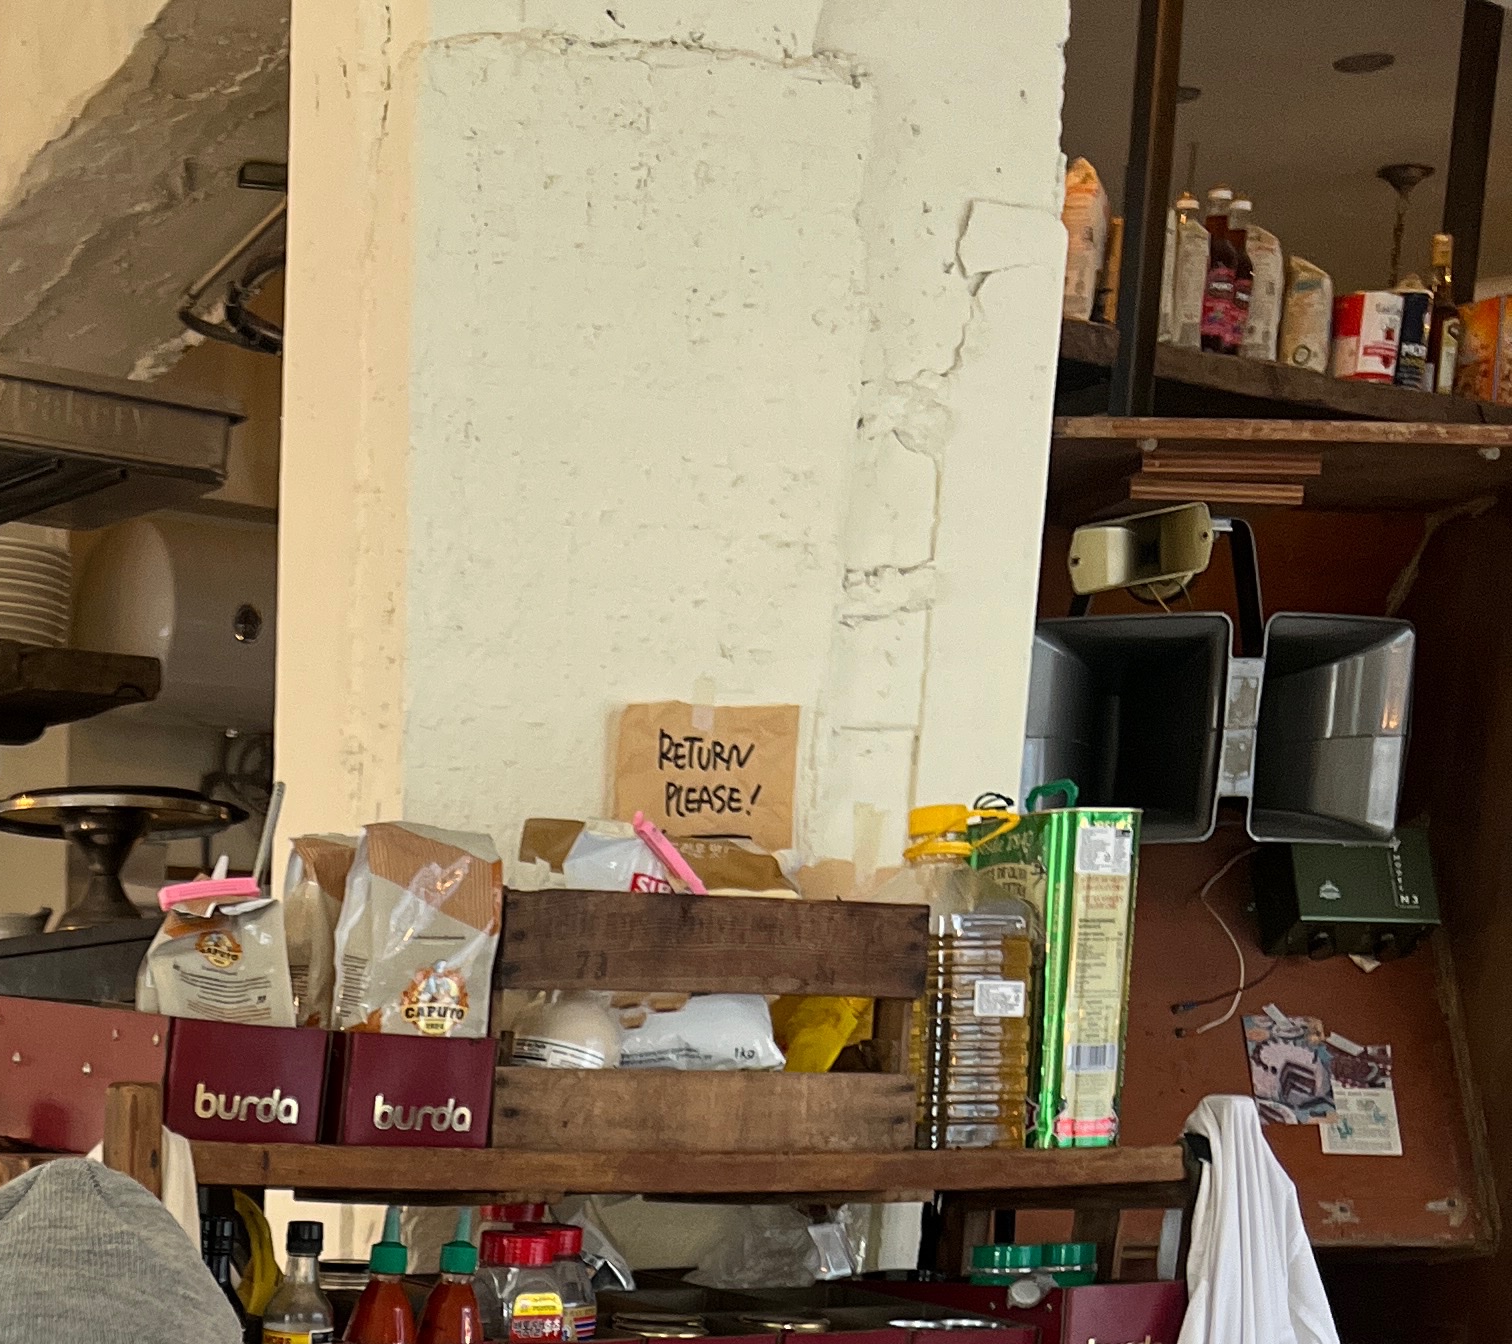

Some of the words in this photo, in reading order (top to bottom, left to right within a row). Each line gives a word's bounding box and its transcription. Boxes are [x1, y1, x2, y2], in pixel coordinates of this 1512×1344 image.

[658, 728, 755, 771] RETURN
[665, 781, 762, 817] PLEASE!
[404, 1006, 465, 1020] CAPUTO
[194, 1080, 299, 1125] burda
[372, 1093, 473, 1132] burda
